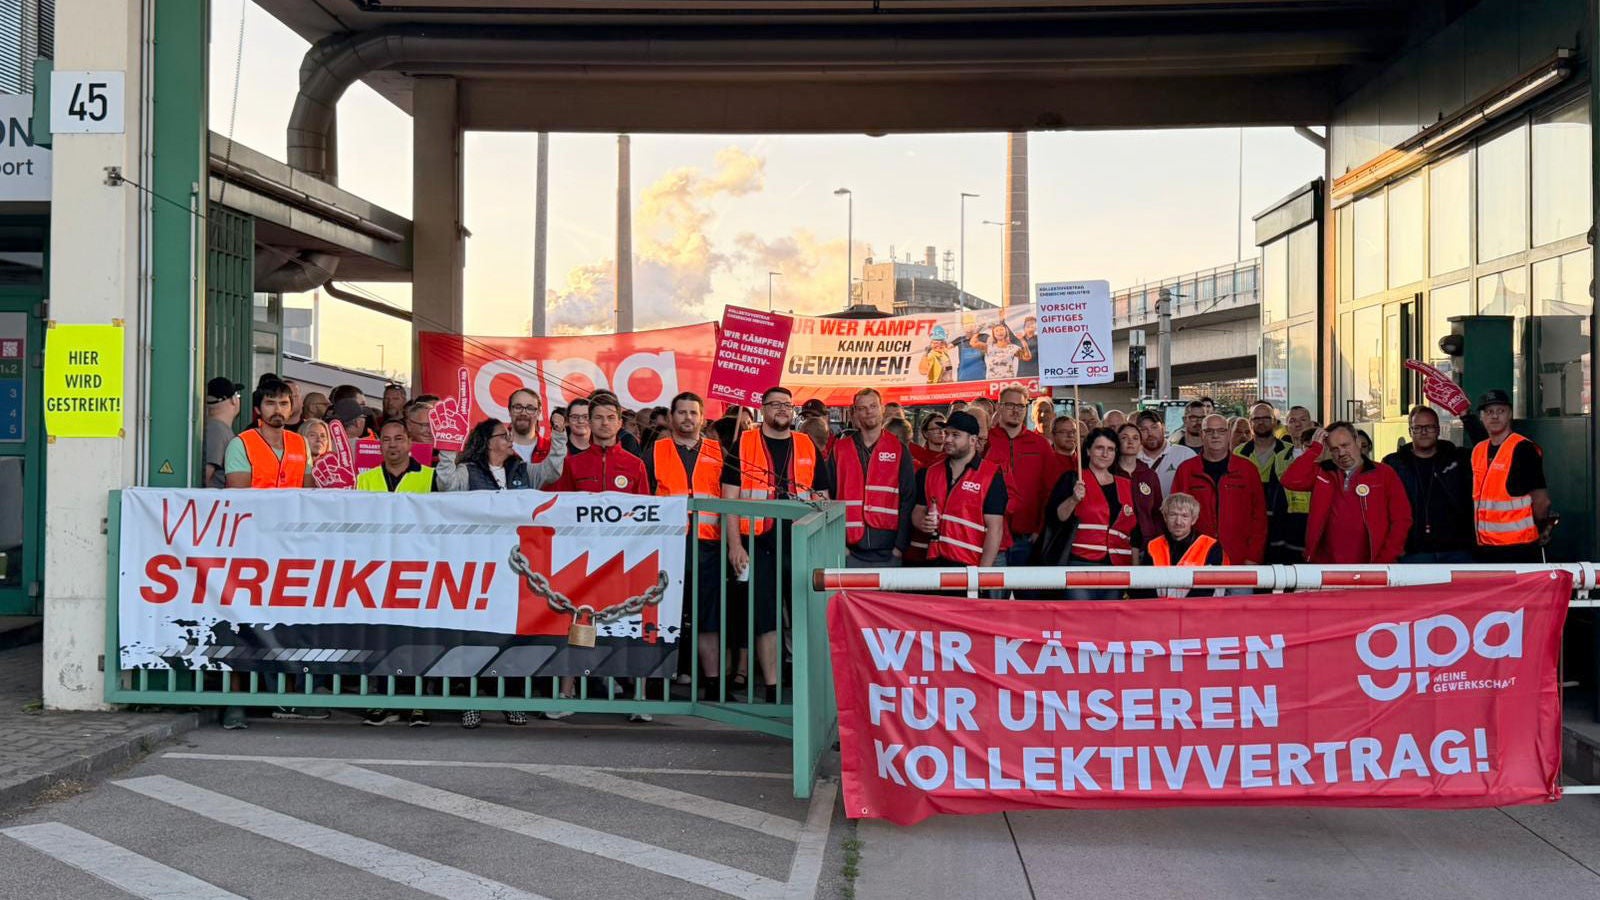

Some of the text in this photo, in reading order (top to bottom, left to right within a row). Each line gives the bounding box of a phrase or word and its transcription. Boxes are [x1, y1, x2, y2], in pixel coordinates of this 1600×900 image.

[68, 83, 107, 121] 45
[0, 117, 33, 147] N
[0, 159, 33, 175] ort
[1040, 302, 1088, 312] VORSICHT
[1041, 314, 1083, 323] GIFTIGES
[793, 319, 815, 334] UR
[820, 320, 858, 336] WER
[1042, 325, 1088, 334] ANGEBOT!
[724, 330, 785, 349] WIR KÄMPFEN
[838, 340, 911, 353] KANN AUCH
[721, 339, 781, 359] FÜR UNSEREN
[69, 351, 99, 365] HIER
[719, 350, 770, 366] KOLLEKTIV-
[788, 355, 911, 376] GEWINNEN!
[718, 359, 760, 375] VERTRAG!
[1044, 367, 1079, 377] PRO-GE
[1086, 365, 1108, 377] gpa
[65, 374, 102, 389] WIRD
[9, 388, 17, 398] 3
[712, 384, 746, 398] PRO-GE
[47, 397, 120, 412] GESTREIKT!
[879, 452, 896, 461] gpa
[962, 481, 981, 491] gpa
[576, 504, 661, 523] PRO-GE
[163, 498, 252, 548] Wir
[139, 554, 497, 610] STREIKEN!
[861, 628, 1284, 675] WIR KÄMPFEN
[1356, 607, 1524, 701] gpa
[1433, 671, 1467, 683] MEINE
[1433, 677, 1517, 693] GEWERKSCHAT
[868, 676, 1280, 731] FÜR UNSEREN
[873, 728, 1490, 791] KOLLEKTIVVERTRAG!
